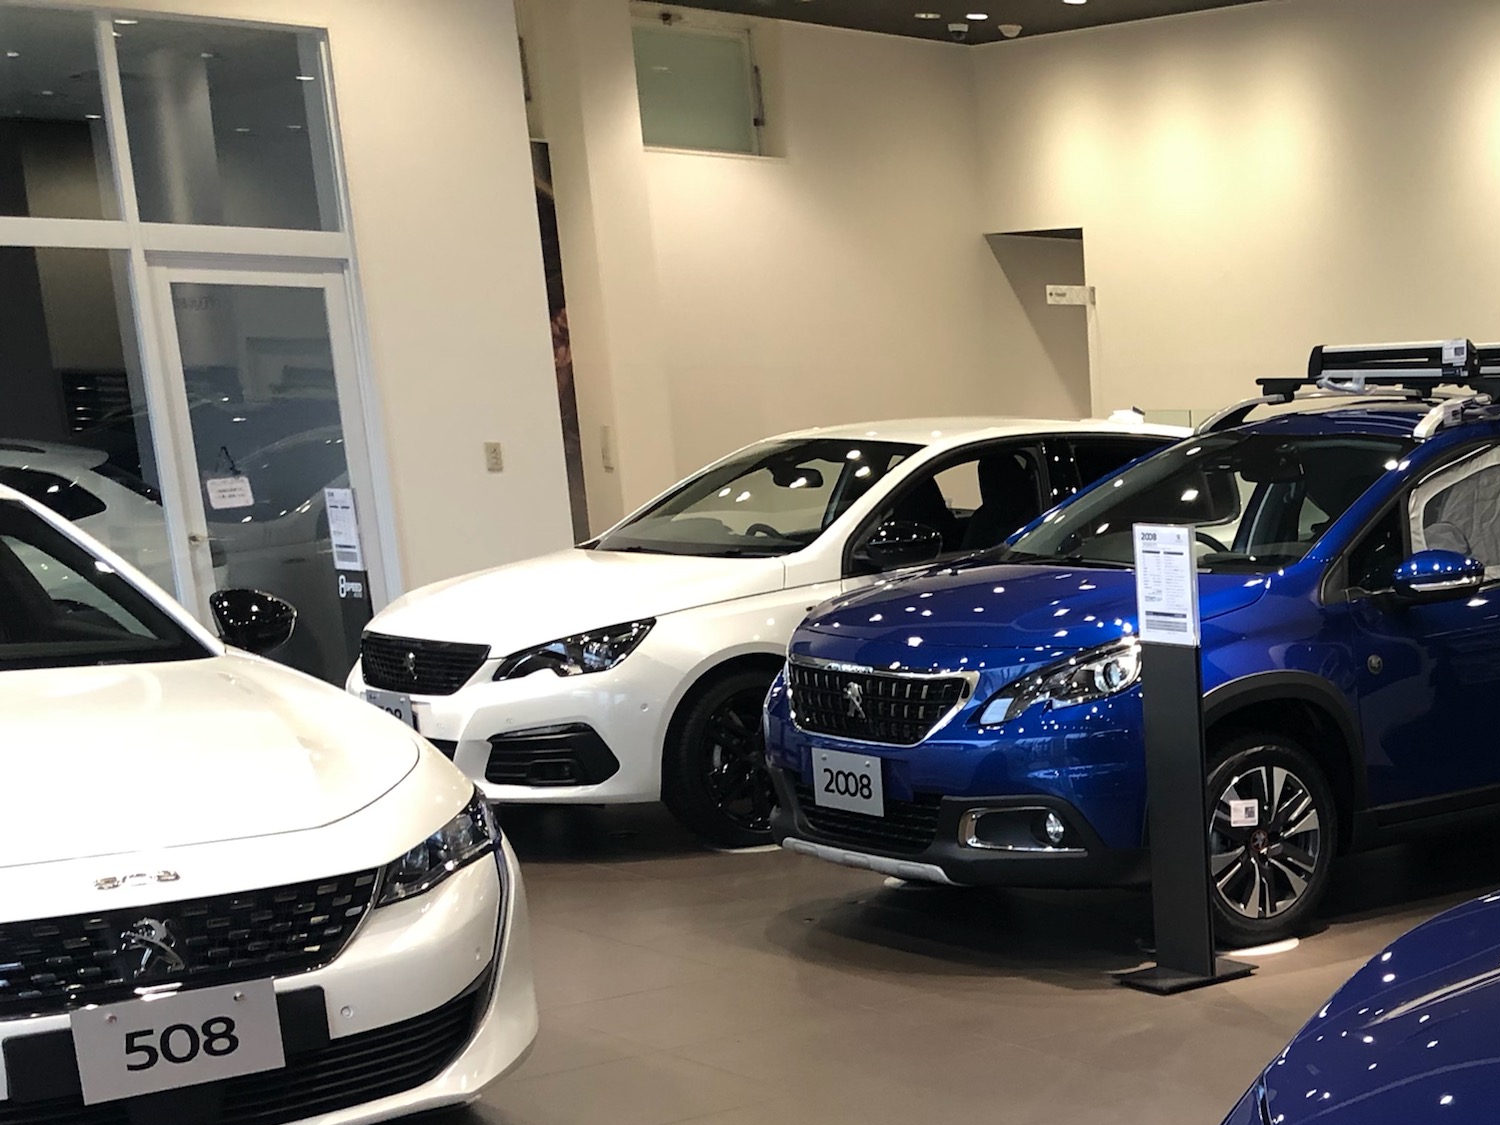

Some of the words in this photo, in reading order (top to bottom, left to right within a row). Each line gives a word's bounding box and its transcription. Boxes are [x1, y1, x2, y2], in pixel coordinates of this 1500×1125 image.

[1140, 532, 1158, 542] 2008
[823, 767, 873, 800] 2008
[125, 1015, 240, 1072] 508
